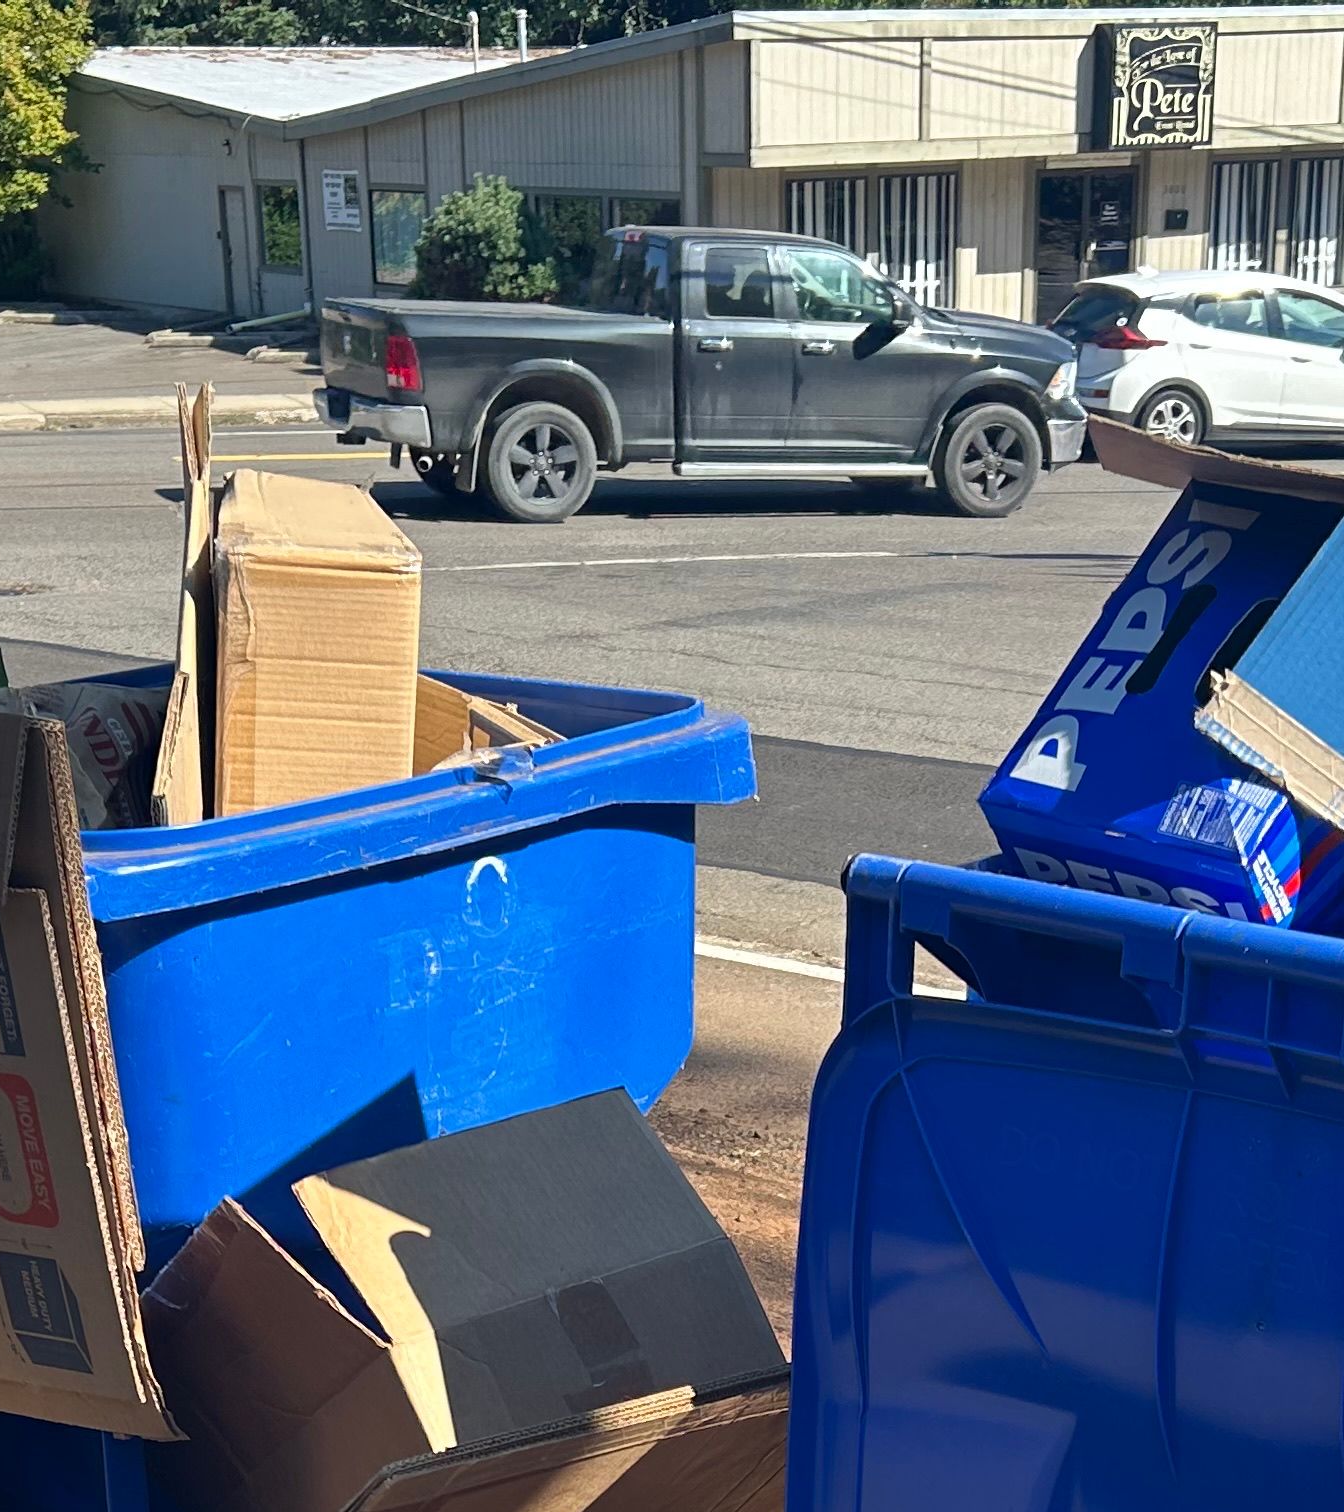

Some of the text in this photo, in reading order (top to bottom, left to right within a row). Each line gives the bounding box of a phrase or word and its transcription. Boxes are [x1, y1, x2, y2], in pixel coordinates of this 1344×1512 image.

[1130, 78, 1195, 132] Pete
[1010, 499, 1263, 792] PEPSI
[16, 1094, 51, 1211] MOVE EASY
[27, 1260, 53, 1332] HEAVY DUTY
